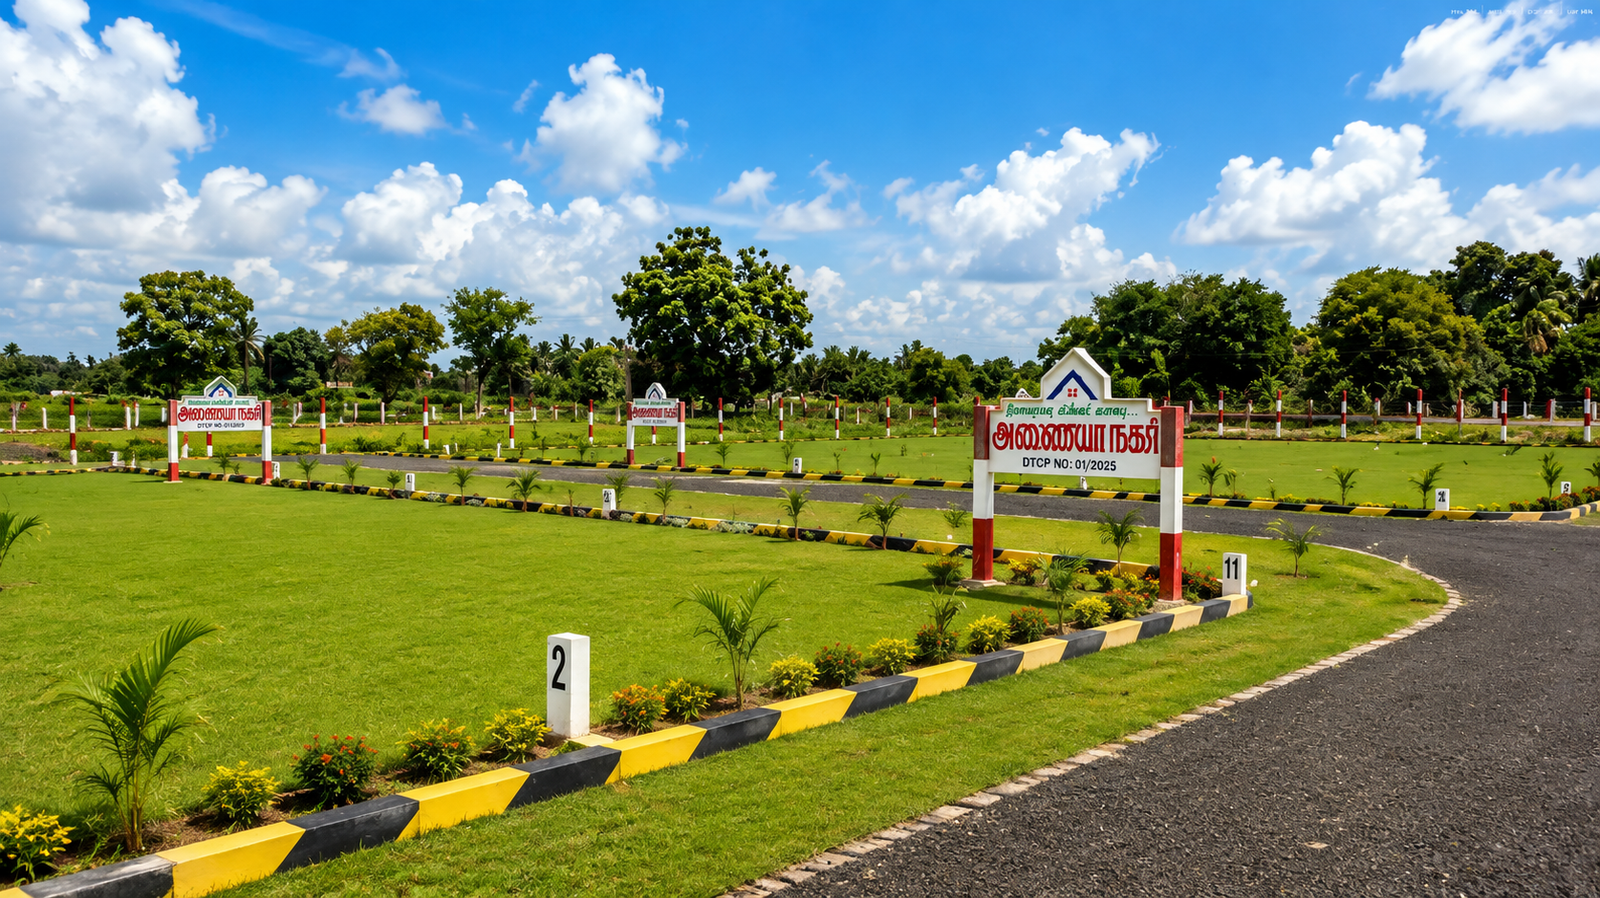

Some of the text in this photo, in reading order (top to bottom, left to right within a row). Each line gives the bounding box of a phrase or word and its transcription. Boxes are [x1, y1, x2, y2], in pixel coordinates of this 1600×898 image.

[1109, 417, 1159, 454] நகர்
[1022, 457, 1117, 472] DTCP NO: 01/2025
[1224, 556, 1239, 580] 11
[552, 644, 566, 692] 2
